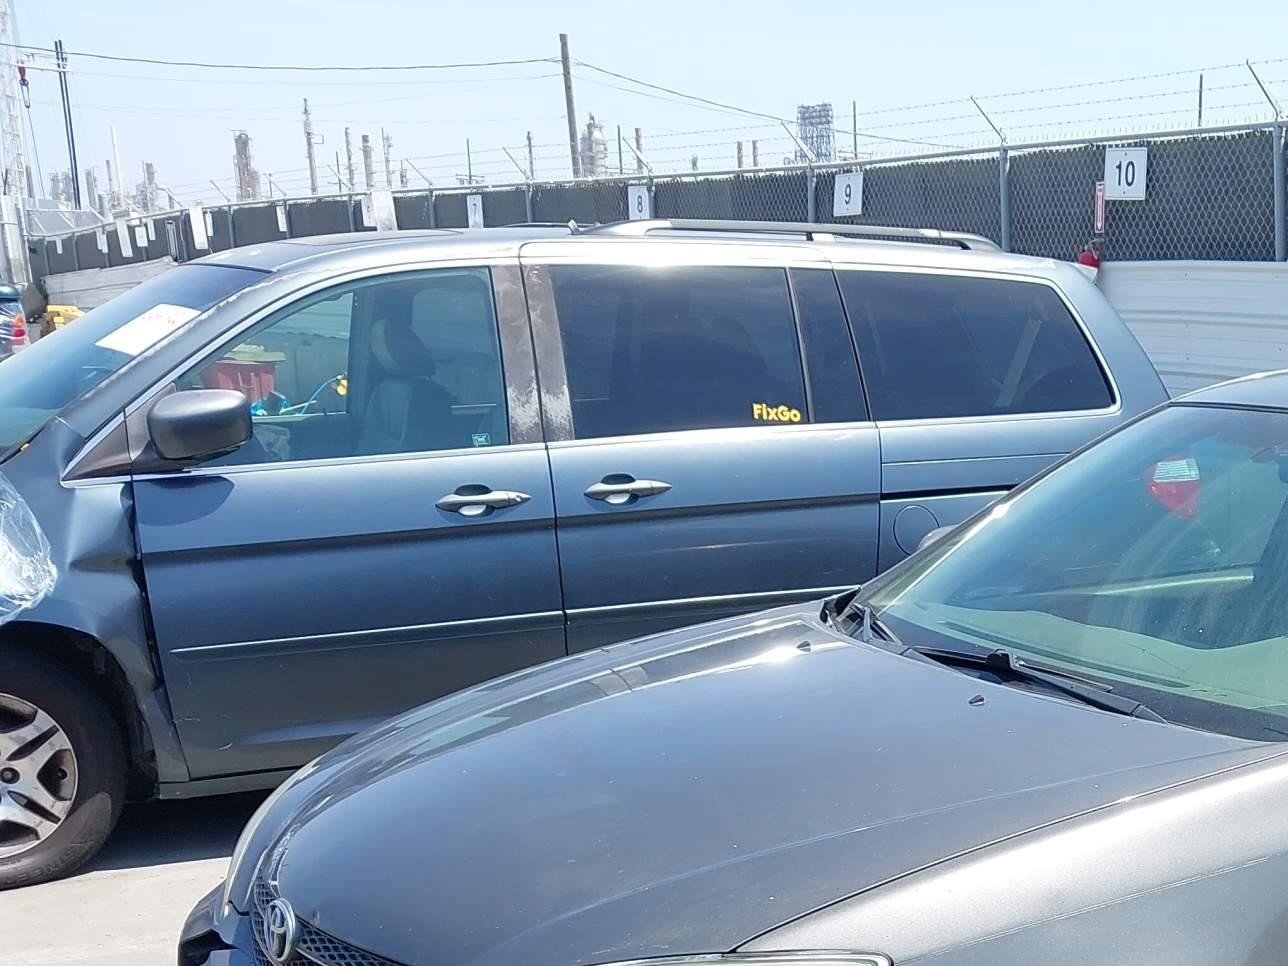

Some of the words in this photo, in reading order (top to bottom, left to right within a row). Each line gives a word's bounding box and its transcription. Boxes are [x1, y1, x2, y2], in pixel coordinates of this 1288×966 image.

[1115, 160, 1136, 187] 10
[636, 194, 644, 214] 8
[843, 183, 852, 205] 9
[752, 402, 801, 422] FixGo
